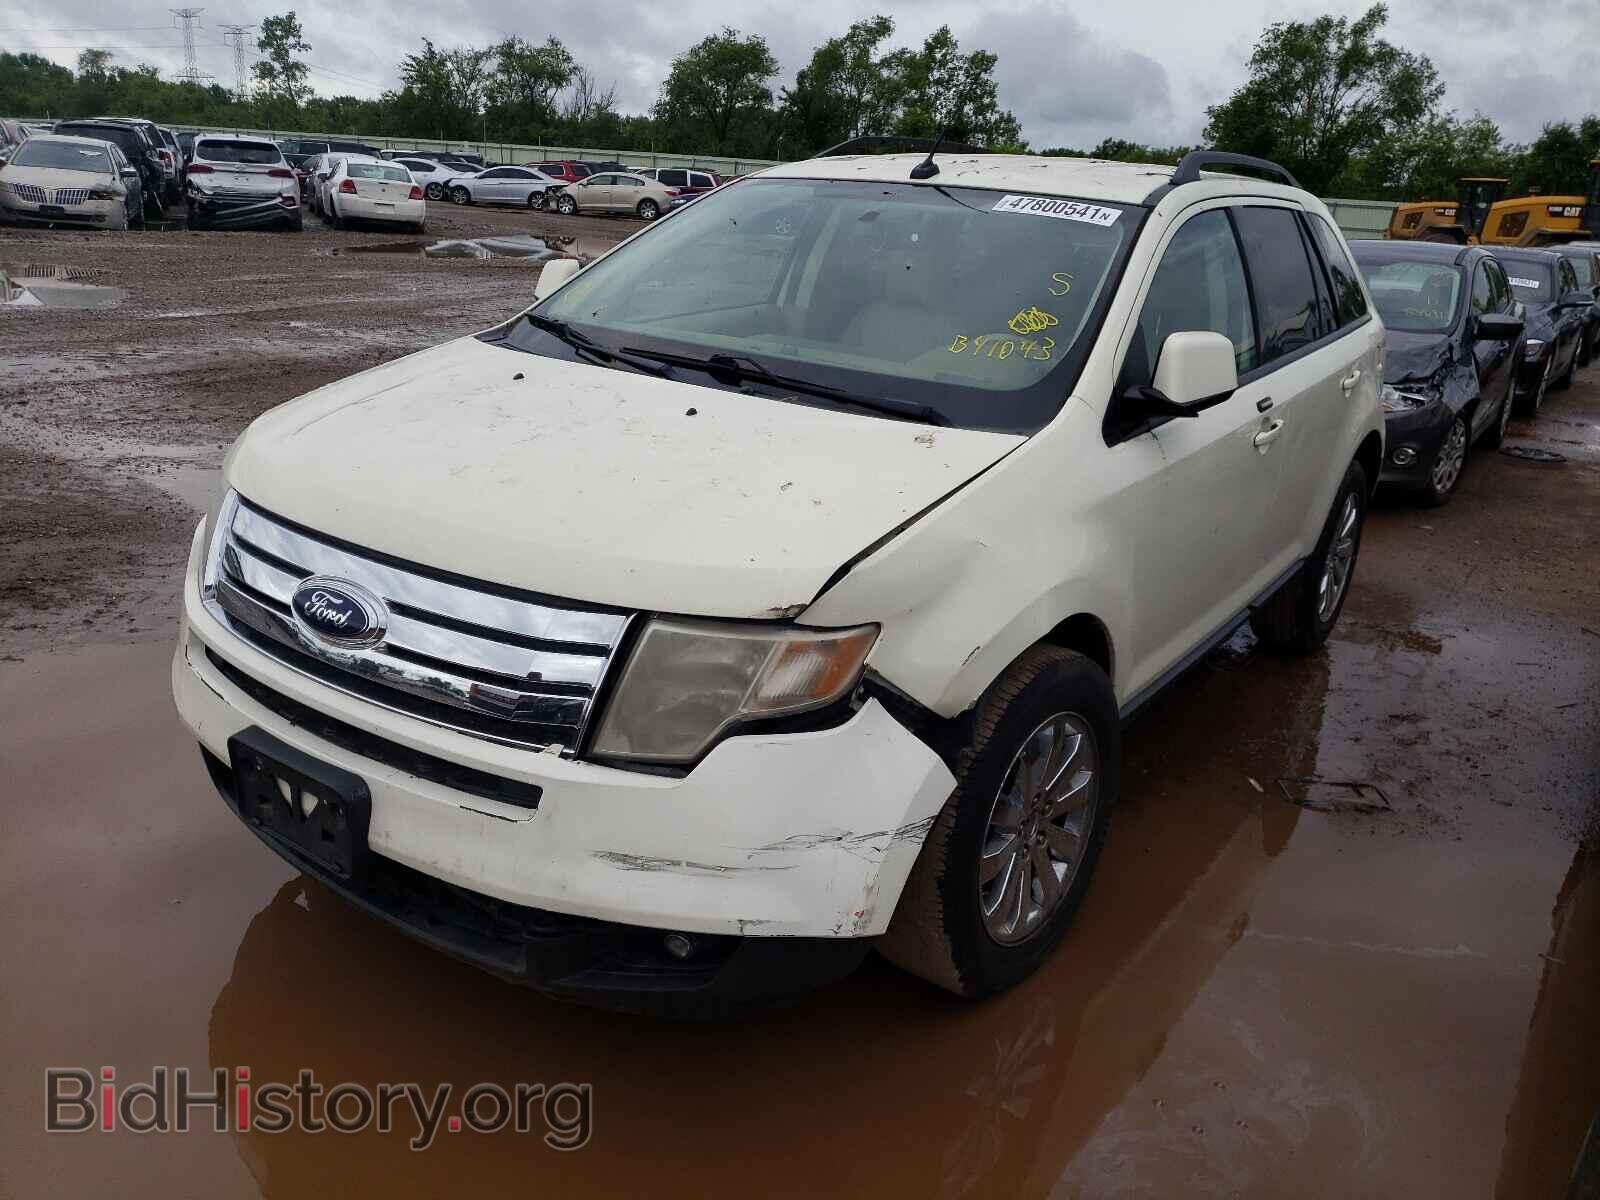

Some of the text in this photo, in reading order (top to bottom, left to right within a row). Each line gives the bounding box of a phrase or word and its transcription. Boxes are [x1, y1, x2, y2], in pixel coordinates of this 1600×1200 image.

[1563, 206, 1582, 217] CAT
[1048, 272, 1073, 296] S
[303, 590, 353, 628] Ford
